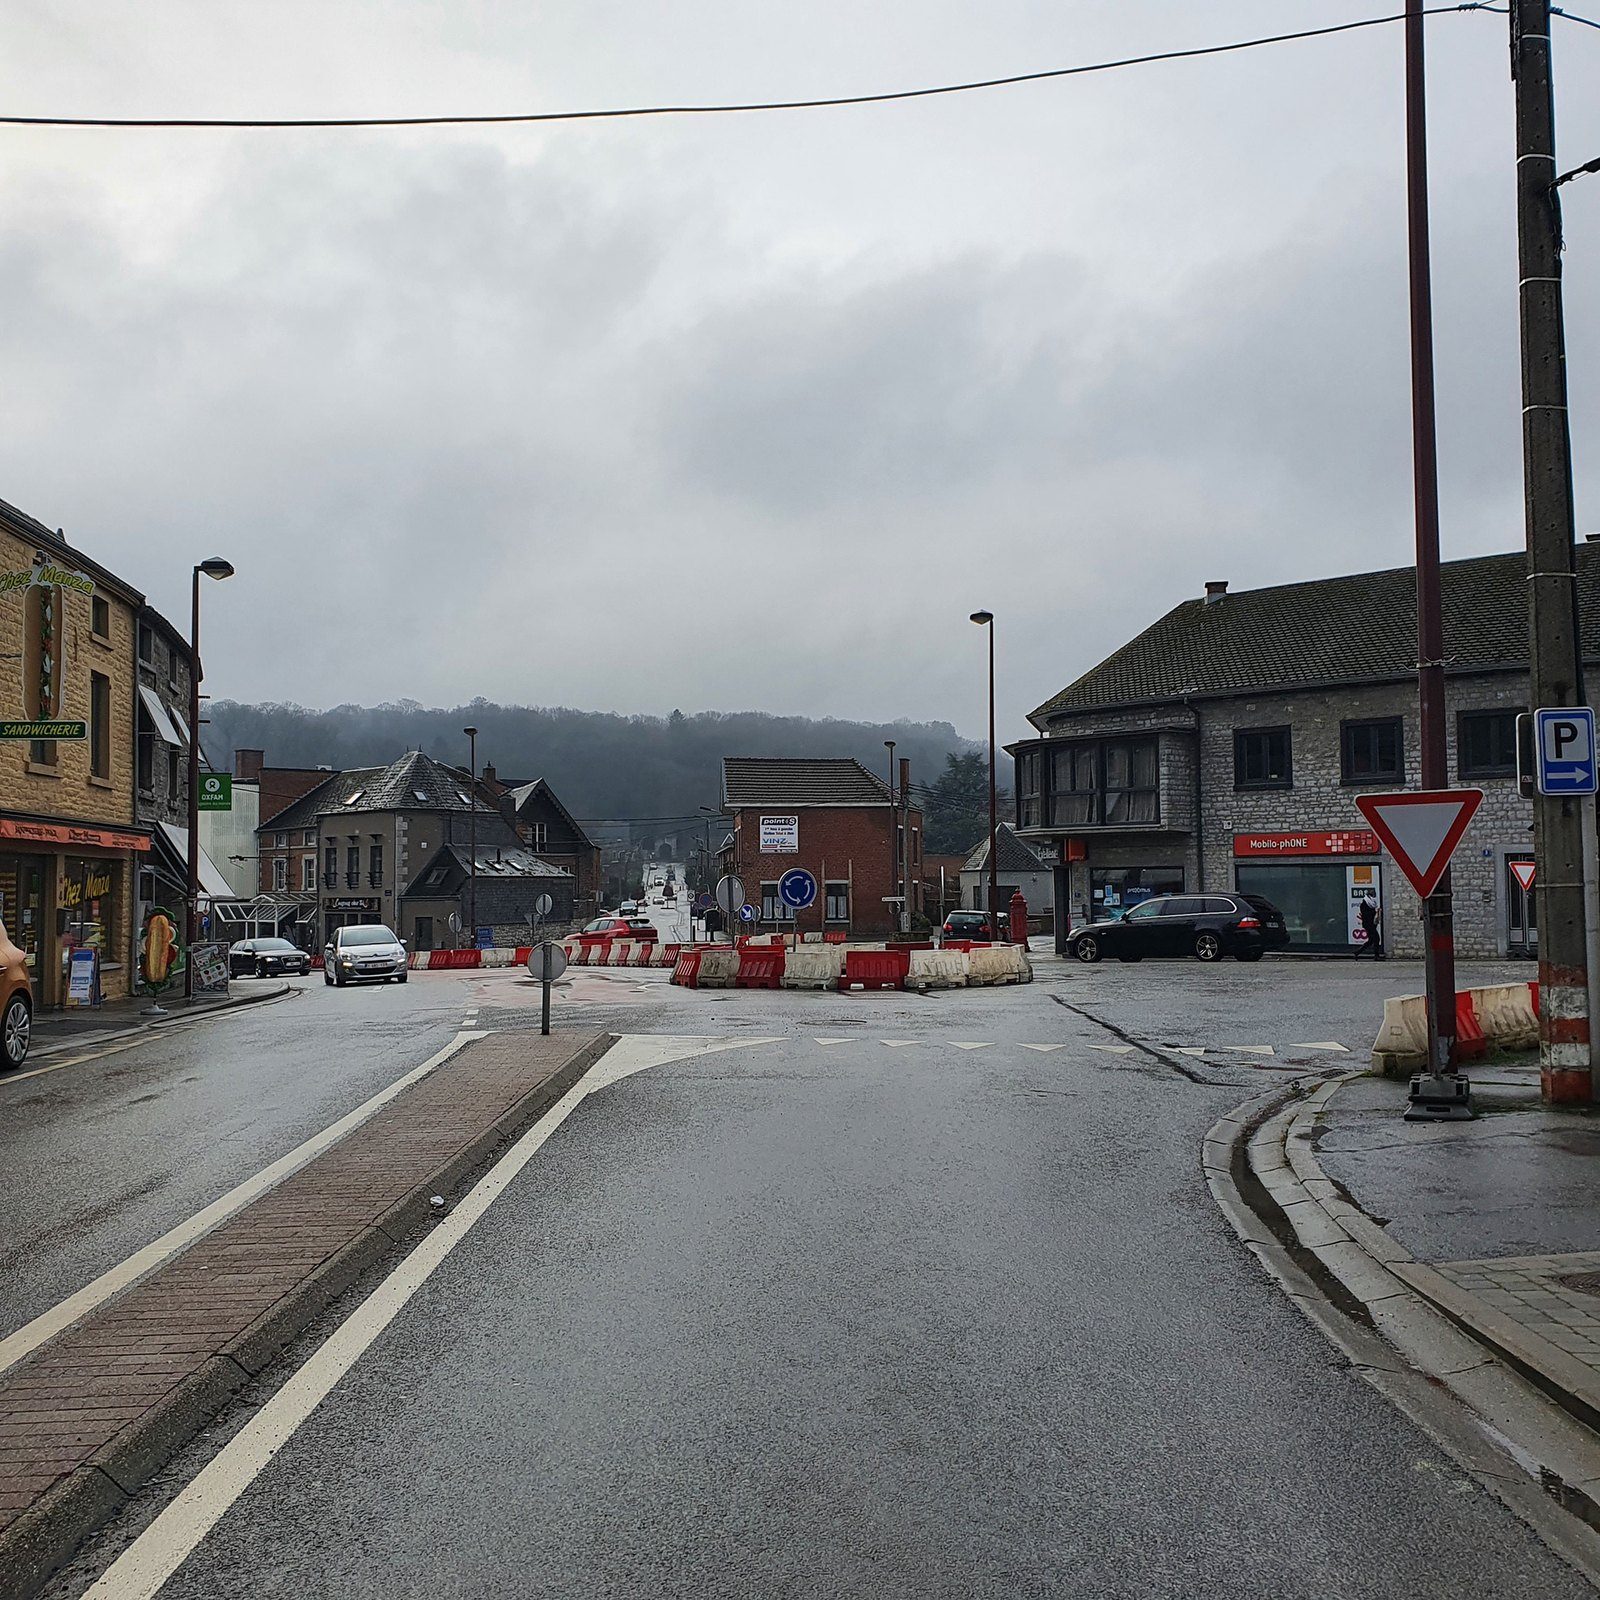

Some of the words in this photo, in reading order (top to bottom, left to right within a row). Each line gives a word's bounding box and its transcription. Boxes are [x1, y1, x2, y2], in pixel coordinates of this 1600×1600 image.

[38, 564, 95, 595] Manza
[2, 724, 80, 736] SANDWICHERIE
[1554, 721, 1578, 759] P
[1250, 838, 1308, 850] Mobilo-phONE
[63, 877, 81, 907] Chez
[84, 872, 110, 900] Manza
[202, 916, 209, 926] P
